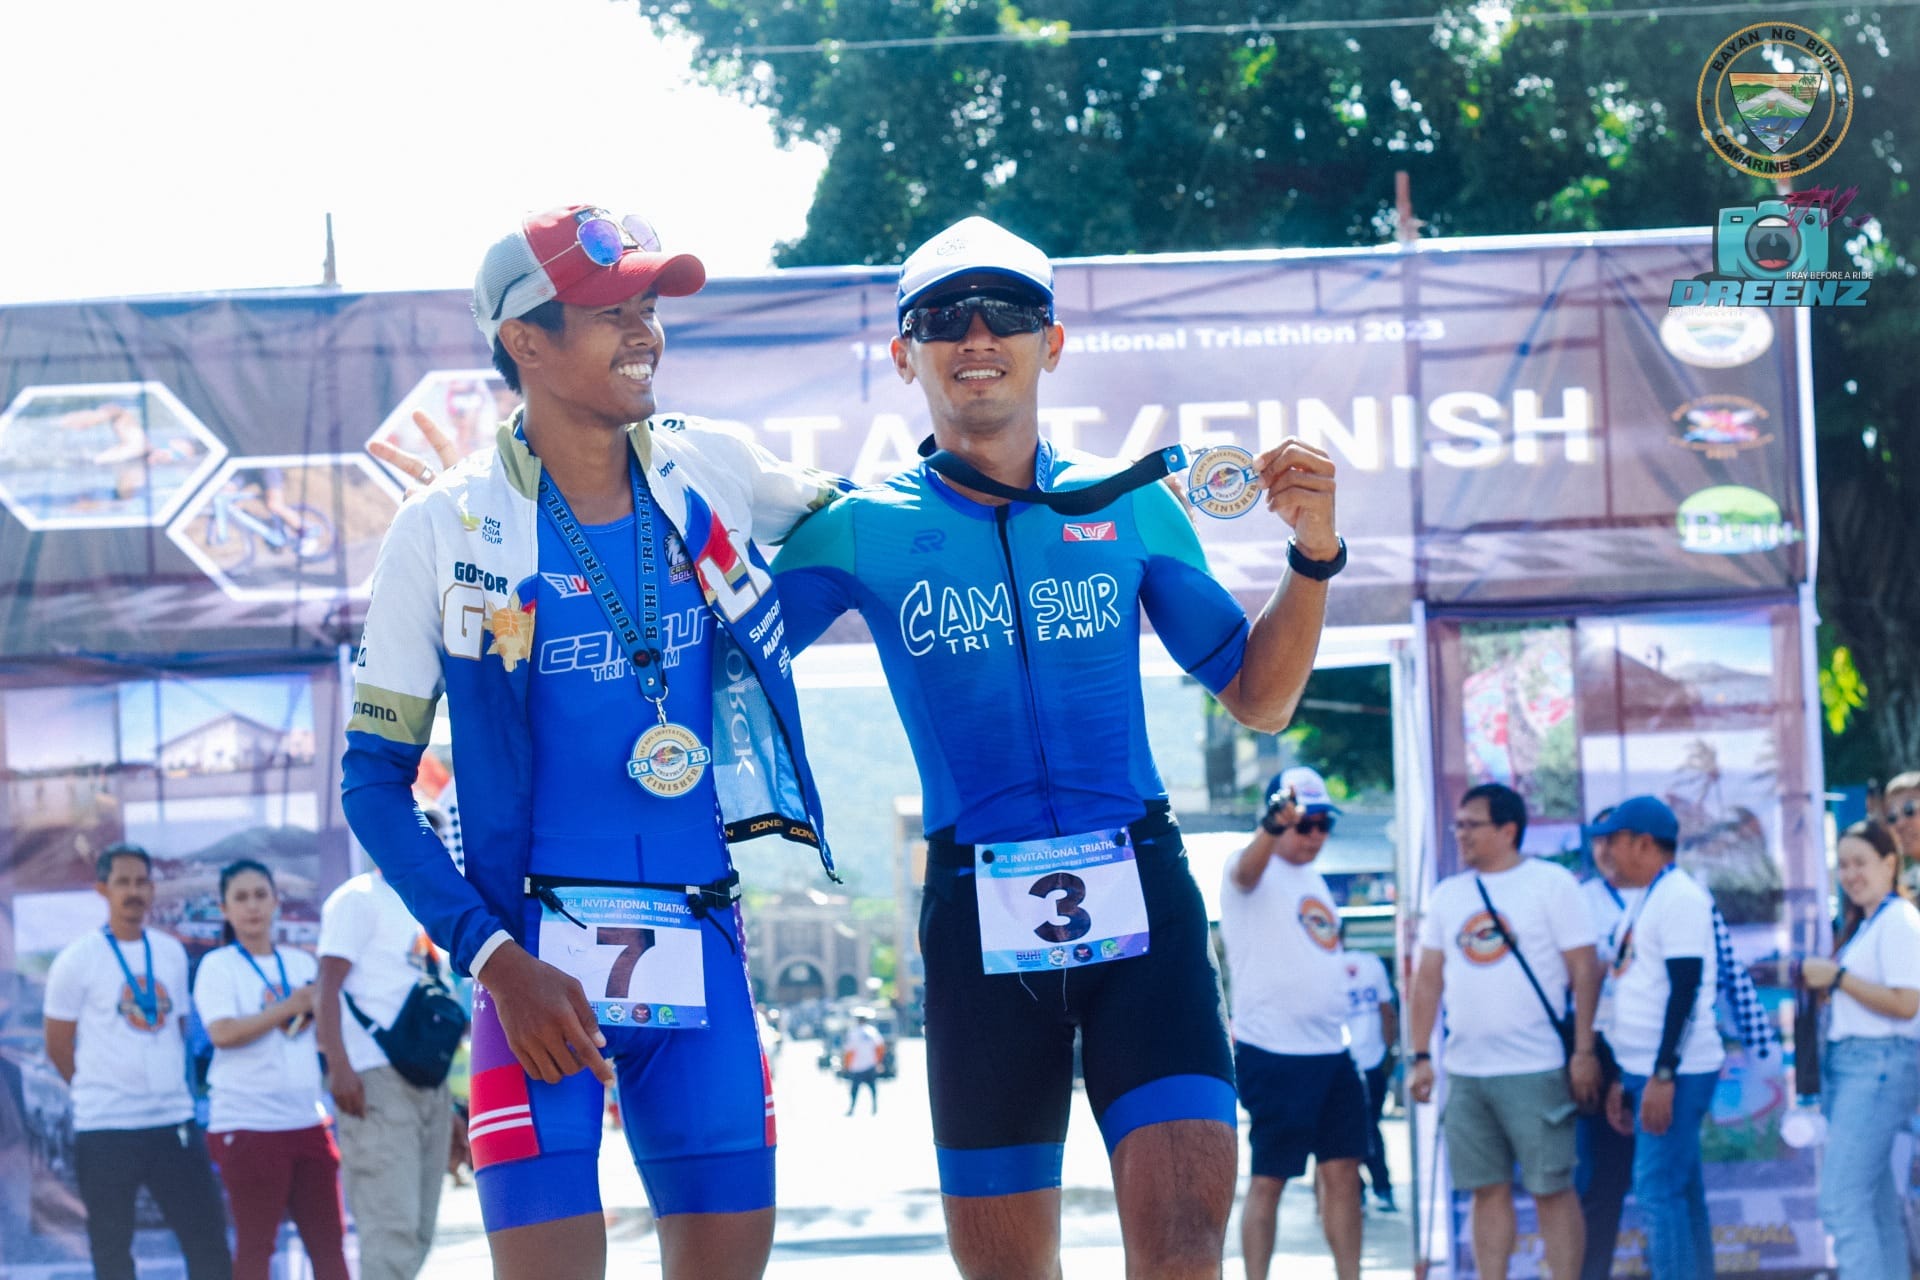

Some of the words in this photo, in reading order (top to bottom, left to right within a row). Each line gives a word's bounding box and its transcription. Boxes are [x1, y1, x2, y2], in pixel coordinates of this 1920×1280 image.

[853, 341, 893, 361] 1s
[1065, 330, 1187, 353] ational
[1195, 322, 1357, 349] Triathlon
[1364, 318, 1447, 342] 2023
[762, 386, 1592, 486] TAT/FINISH
[1191, 489, 1208, 503] 20
[1207, 484, 1258, 513] FINISHER
[482, 524, 500, 536] ASIA
[484, 515, 501, 529] UCI
[539, 480, 605, 586] TRIATHLO
[636, 481, 656, 576] TRIATHL
[481, 532, 503, 544] TOUR
[602, 590, 639, 646] BUHI
[643, 583, 658, 641] BUHI
[748, 599, 781, 644] SHIMAN
[900, 579, 1013, 657] CAM
[1029, 572, 1121, 632] SUR
[946, 633, 990, 655] TRI
[591, 660, 625, 682] TRI
[353, 701, 398, 722] MANO
[632, 762, 649, 774] 20
[690, 750, 706, 763] 23
[646, 768, 699, 792] FINISHER
[1010, 848, 1079, 864] INVITATIONAL
[581, 898, 652, 911] INVITATIONAL
[652, 901, 692, 915] TRIATHLO
[1028, 872, 1092, 943] 3
[596, 927, 655, 998] 7
